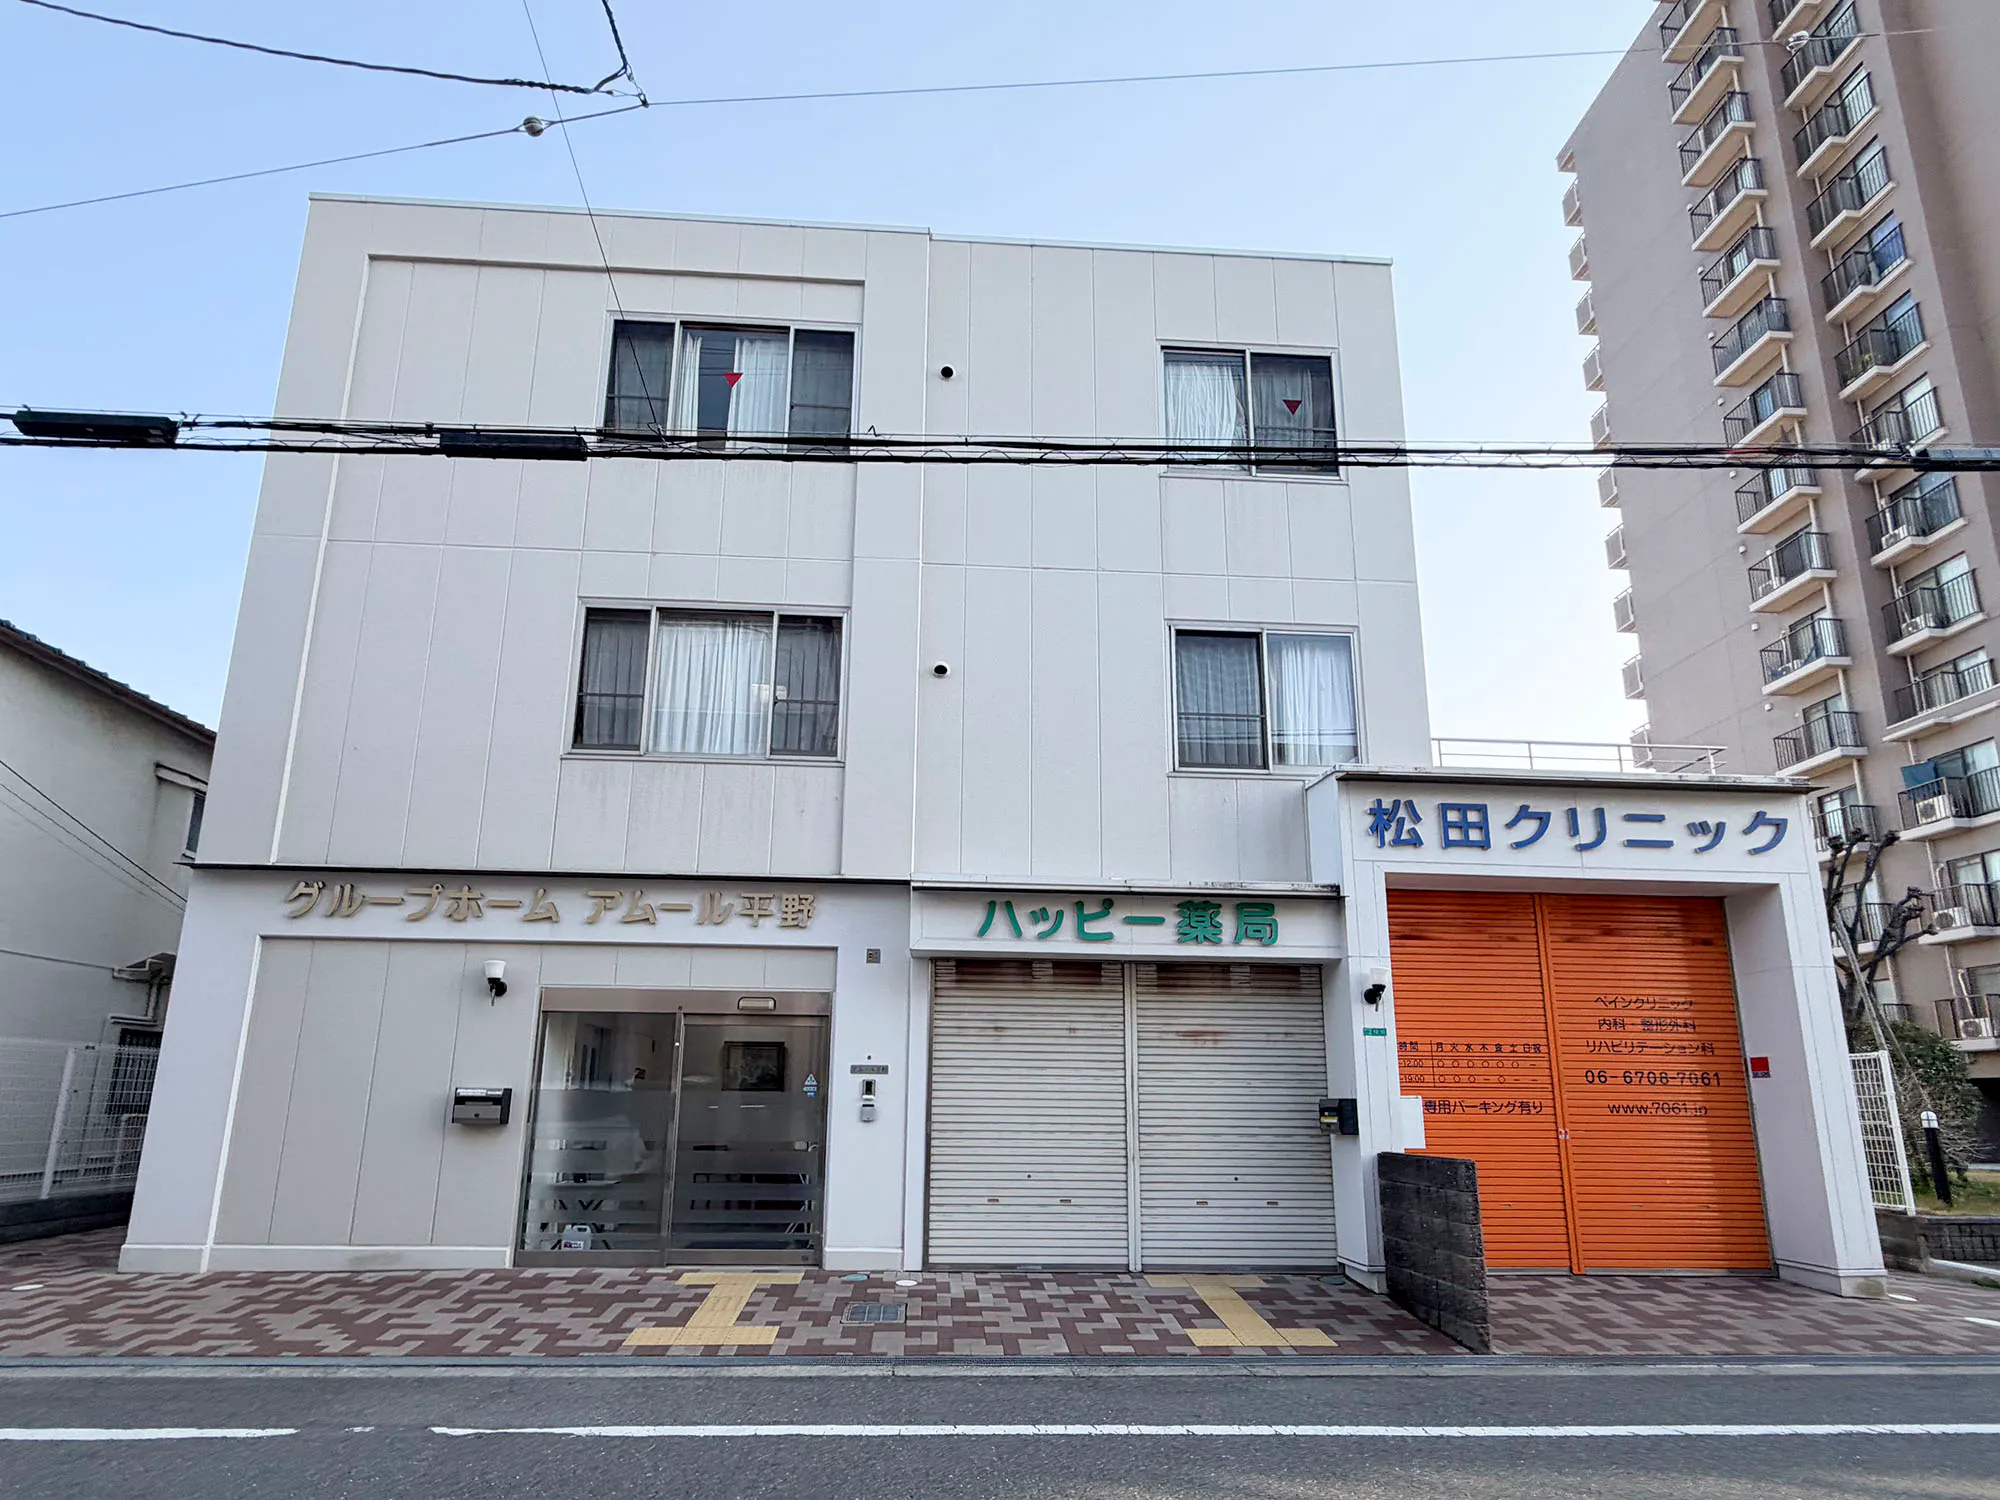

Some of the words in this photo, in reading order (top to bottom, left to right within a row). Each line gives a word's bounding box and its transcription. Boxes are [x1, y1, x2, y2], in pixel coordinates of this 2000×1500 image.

[1366, 798, 1789, 855] 松田クリニック
[285, 880, 560, 924] グループホーム
[585, 889, 817, 928] アムール平野
[977, 897, 1280, 945] ハッピー薬局
[1593, 995, 1694, 1010] ペインクリニック
[1585, 1040, 1715, 1055] リハビリテーション科
[1584, 1069, 1721, 1087] 06-6708-7061
